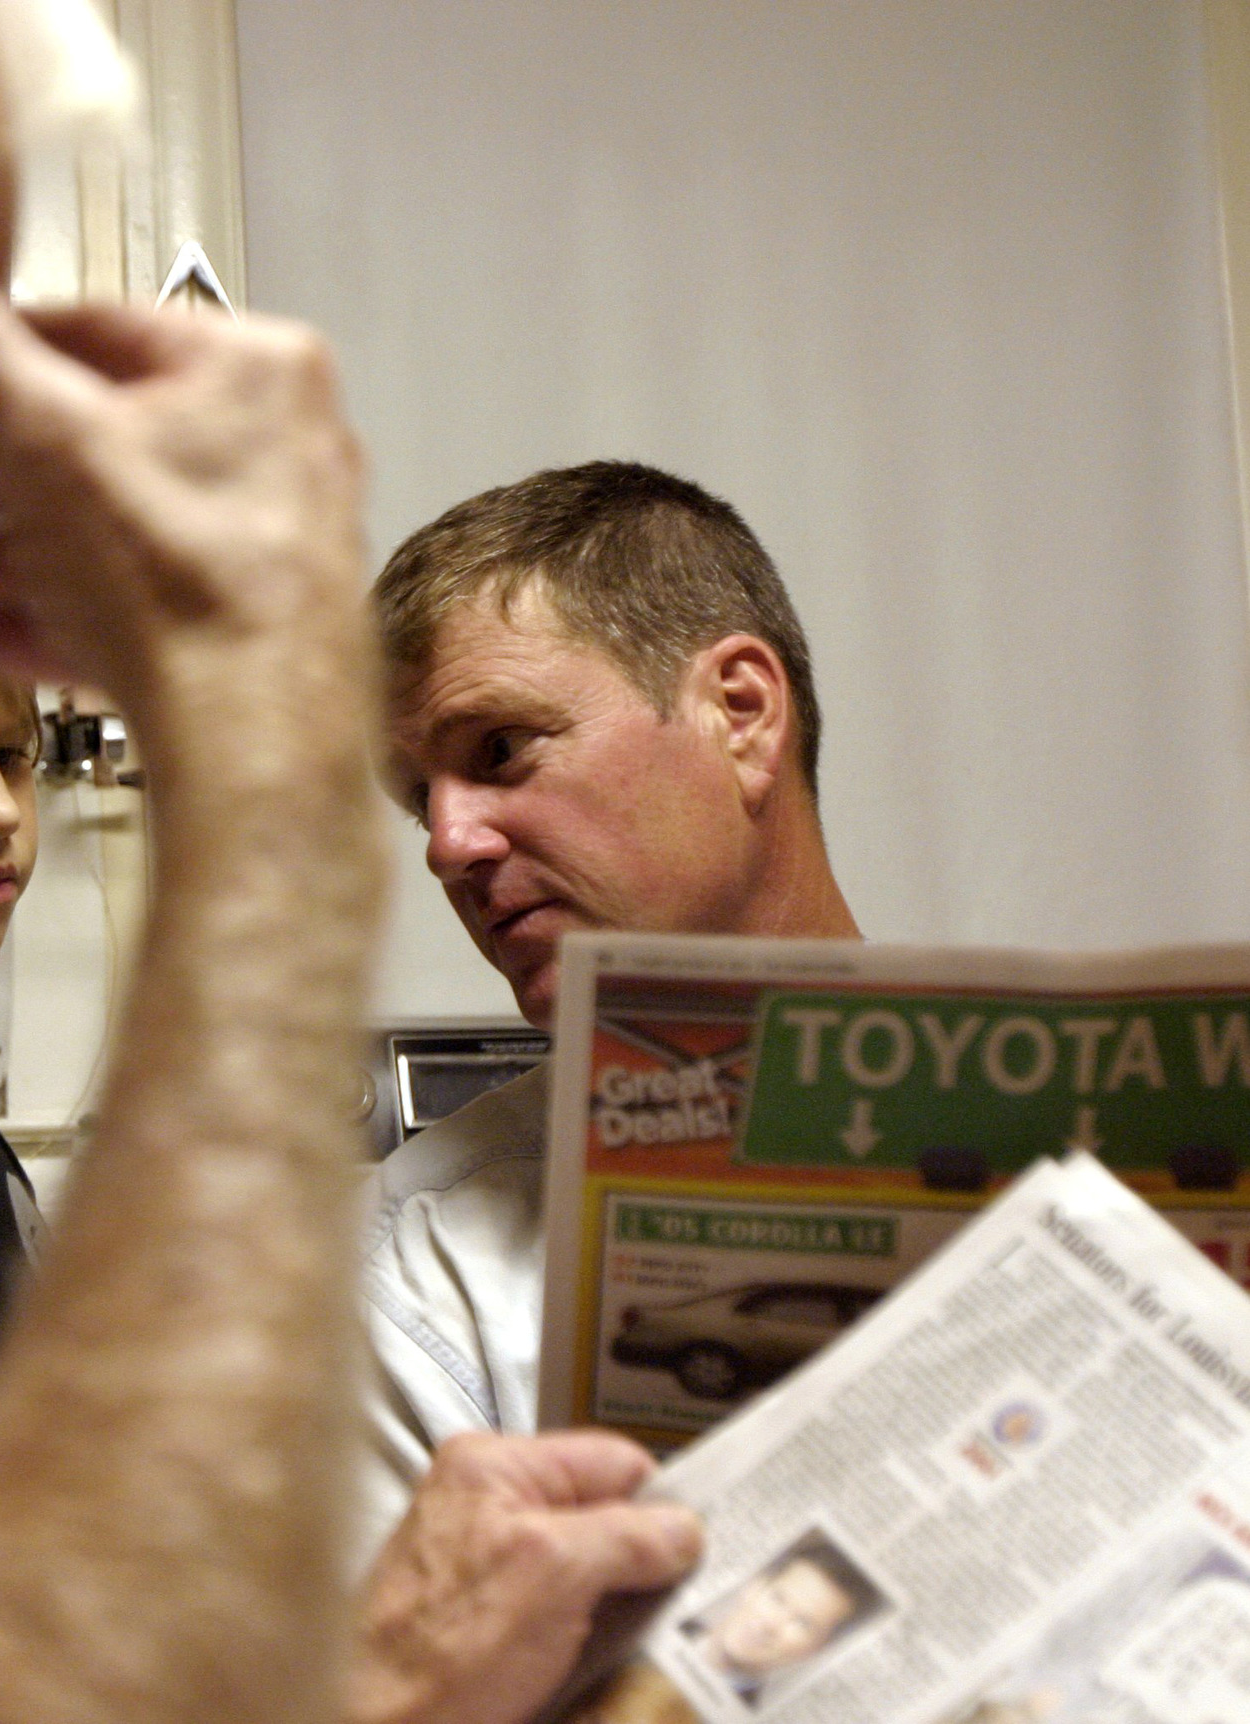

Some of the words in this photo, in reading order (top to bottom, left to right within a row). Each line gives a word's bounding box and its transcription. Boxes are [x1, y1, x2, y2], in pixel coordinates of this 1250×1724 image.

[781, 1009, 1168, 1094] TOYOTA
[600, 1060, 721, 1106] Great
[600, 1099, 733, 1148] Deals!
[1130, 1283, 1168, 1323] for
